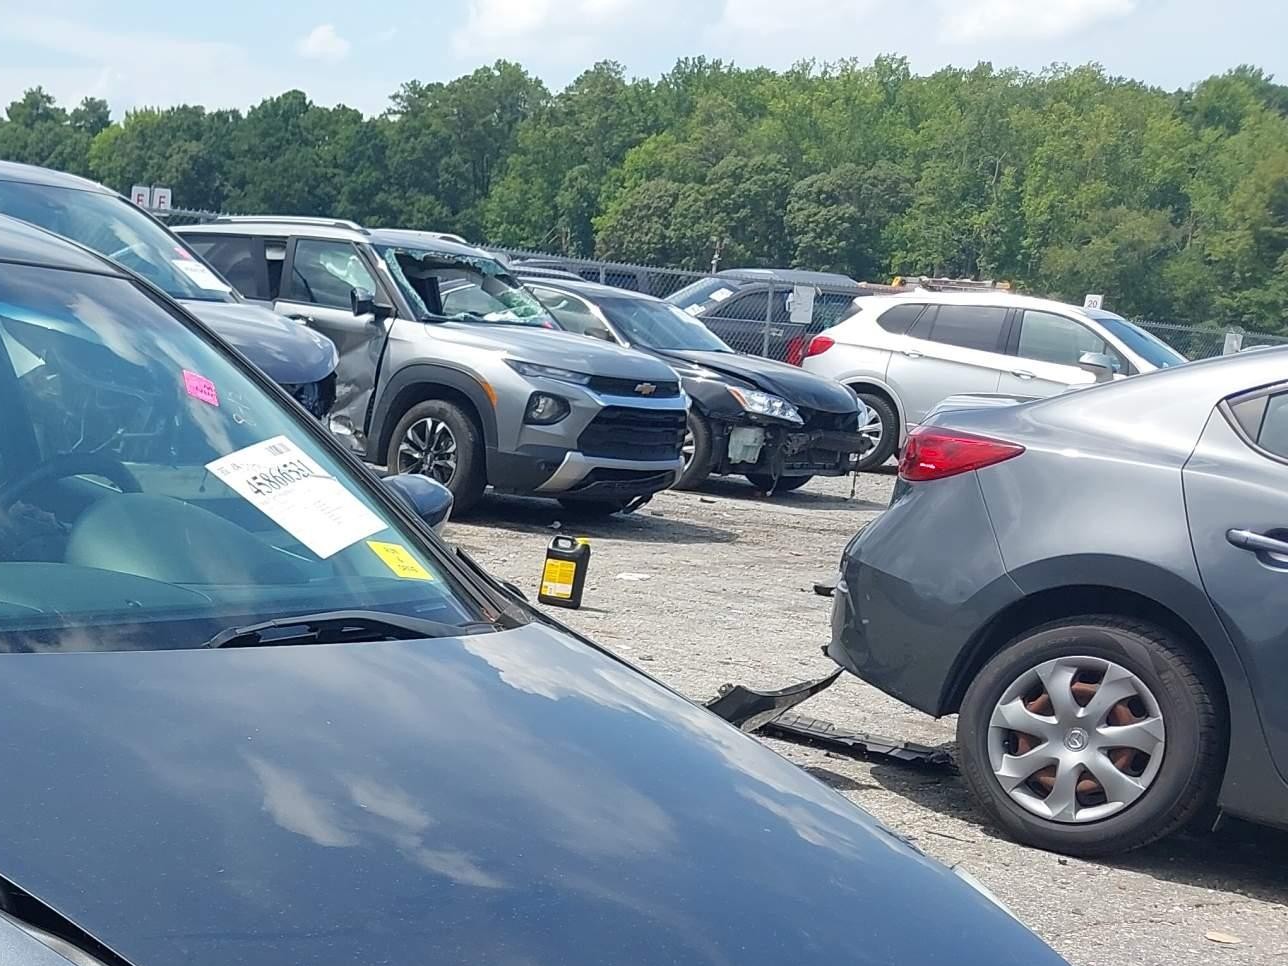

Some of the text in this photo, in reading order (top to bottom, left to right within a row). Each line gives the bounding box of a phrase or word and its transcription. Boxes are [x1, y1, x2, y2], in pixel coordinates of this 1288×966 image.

[159, 195, 167, 208] F
[1087, 299, 1098, 309] 20
[246, 459, 314, 496] 45866531
